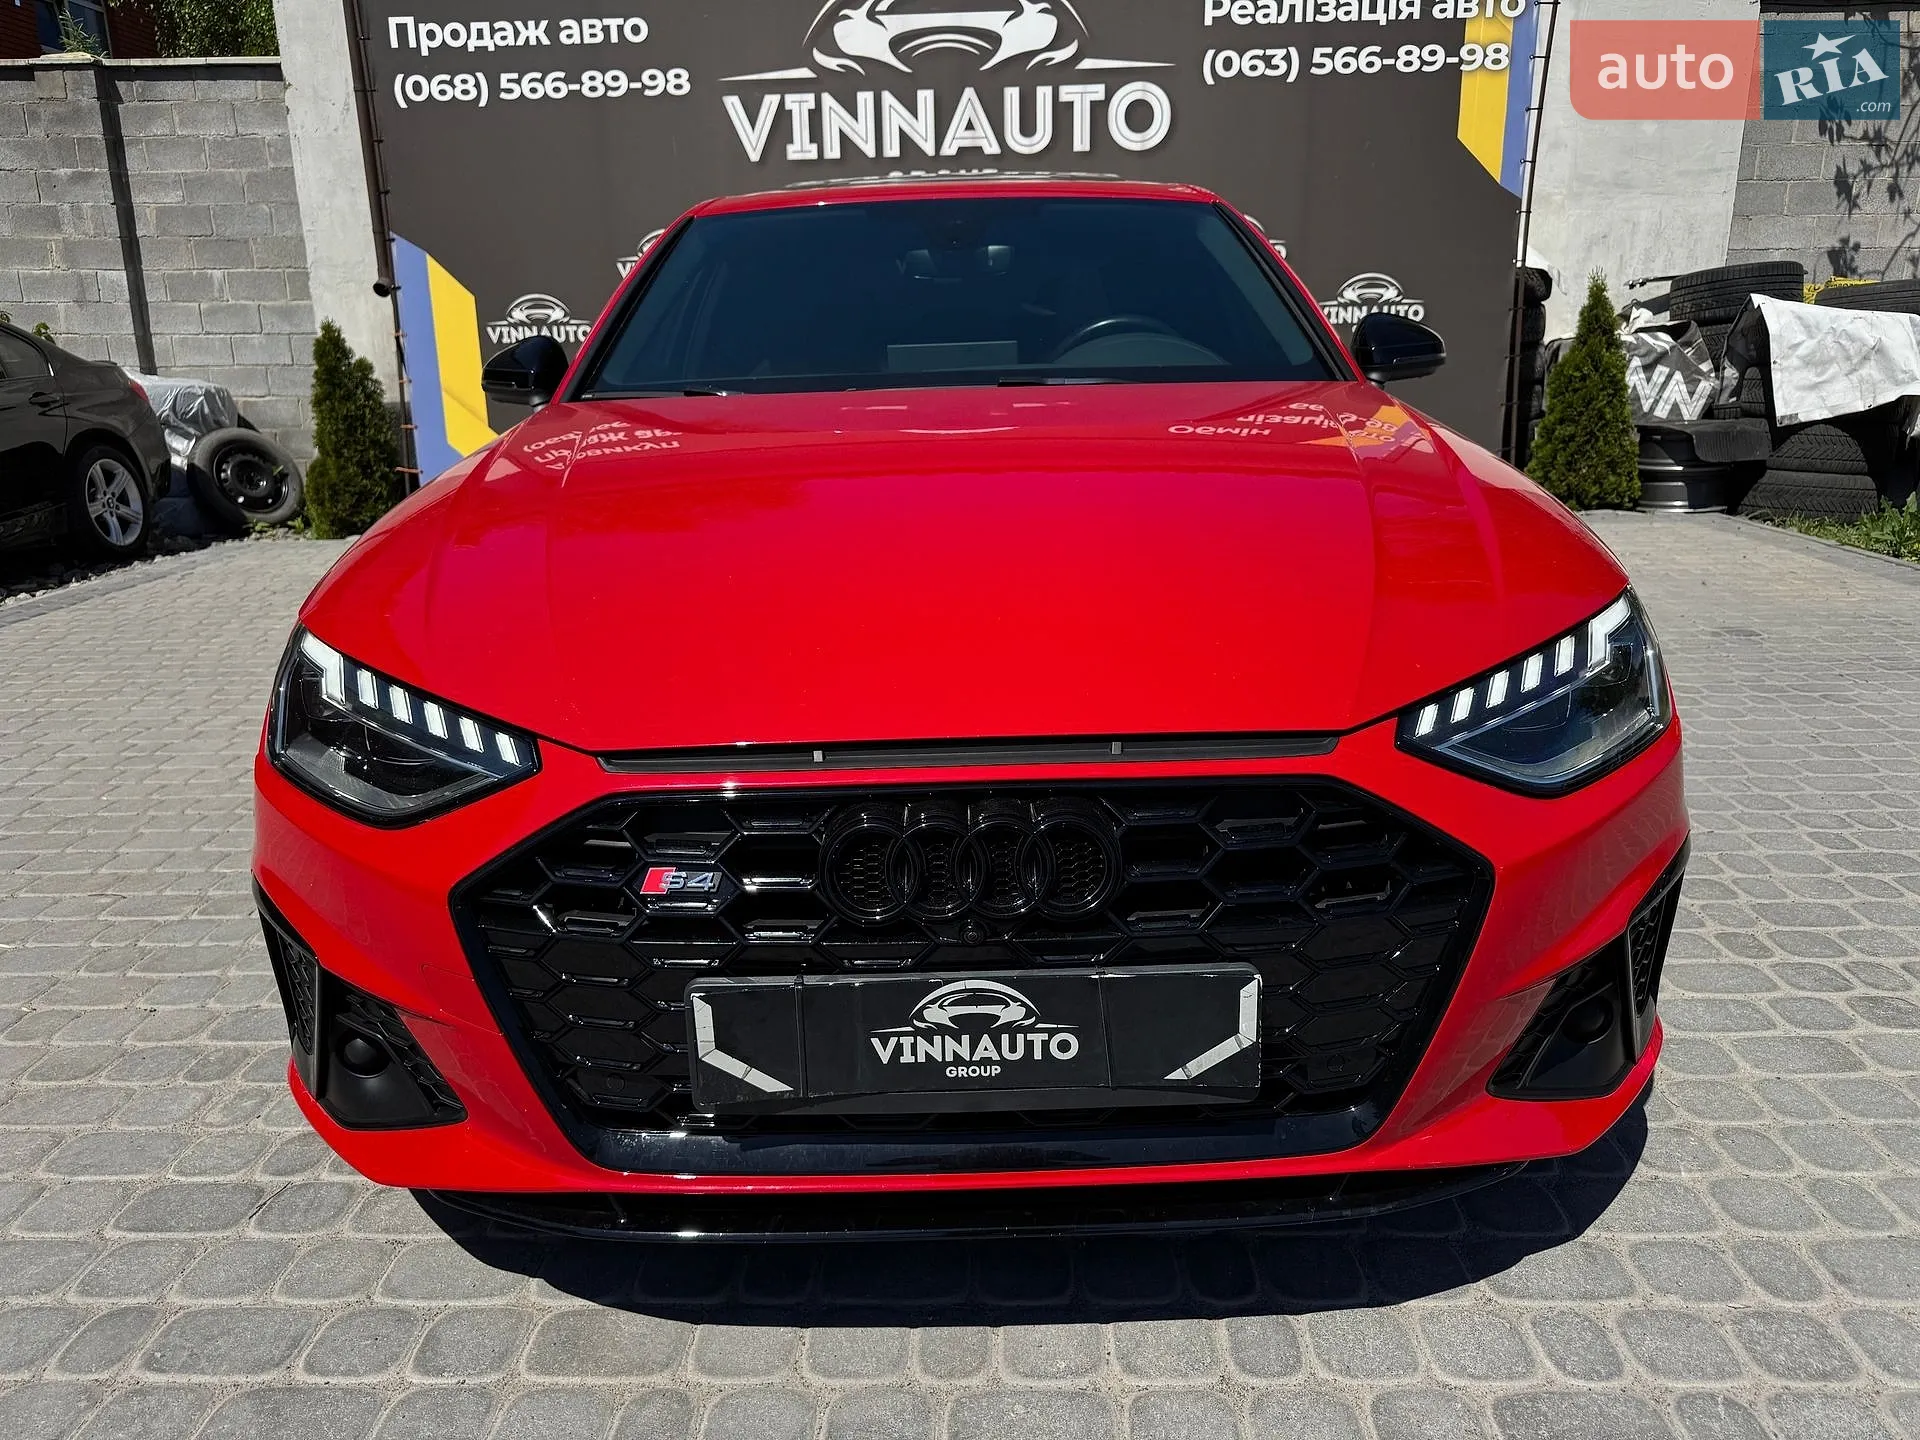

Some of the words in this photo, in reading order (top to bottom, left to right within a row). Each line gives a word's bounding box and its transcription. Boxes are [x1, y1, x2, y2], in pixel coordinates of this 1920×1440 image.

[1204, 0, 1421, 26] Реалізація
[1432, 0, 1526, 19] авто
[388, 16, 551, 56] Продаж
[558, 17, 649, 46] авто
[1203, 47, 1300, 85] (063)
[1310, 44, 1511, 75] 566-89-98
[394, 73, 489, 108] (068)
[499, 68, 692, 100] 566-89-98
[722, 80, 1172, 162] VINNAUTO
[660, 871, 717, 892] S4
[870, 1033, 1079, 1064] VINNAUTO
[945, 1065, 1001, 1078] GROUP
